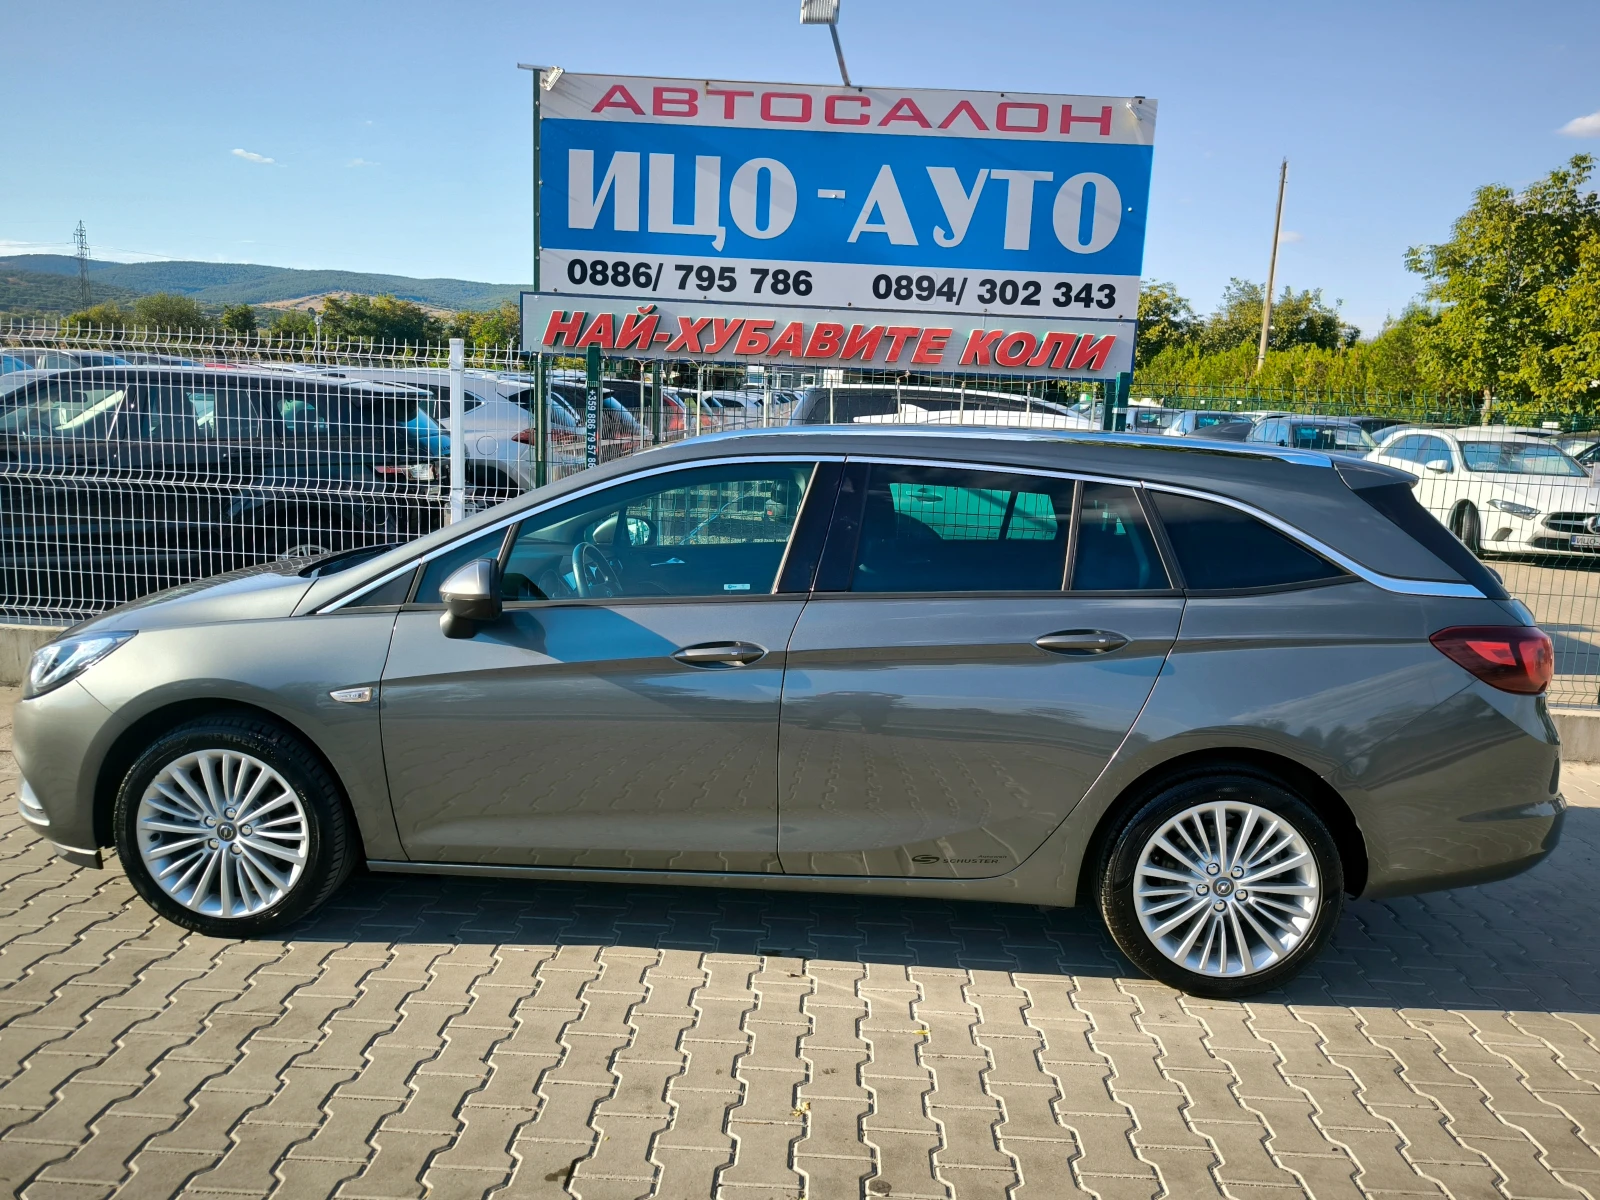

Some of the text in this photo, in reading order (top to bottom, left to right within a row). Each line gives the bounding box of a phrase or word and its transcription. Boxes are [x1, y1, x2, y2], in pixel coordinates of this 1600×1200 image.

[591, 84, 1113, 136] АВТОСАЛОН
[567, 258, 813, 296] 0886/ 795 786
[872, 274, 1117, 309] 0894/ 302 343
[541, 303, 1117, 371] НАЙ-ХУБАВИТЕ КОЛИ
[587, 390, 597, 411] +359
[587, 413, 596, 429] 886
[587, 432, 596, 443] 79
[587, 444, 597, 455] 57
